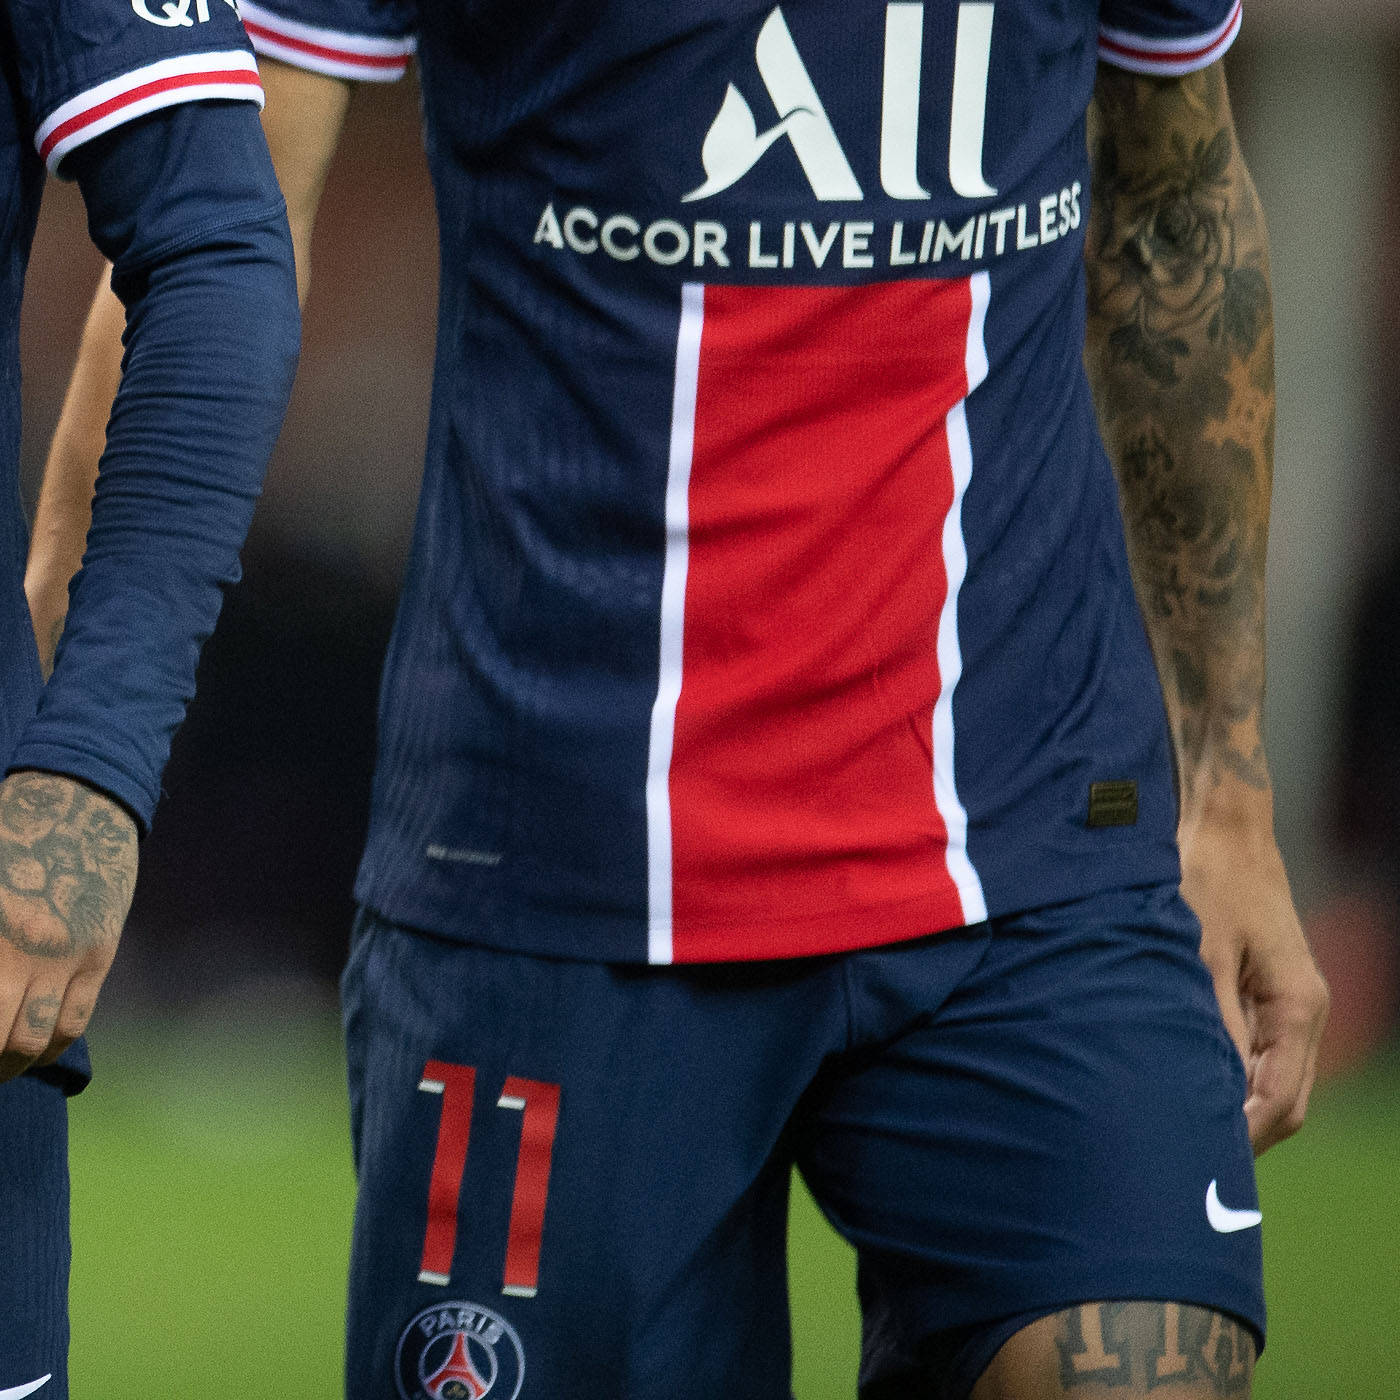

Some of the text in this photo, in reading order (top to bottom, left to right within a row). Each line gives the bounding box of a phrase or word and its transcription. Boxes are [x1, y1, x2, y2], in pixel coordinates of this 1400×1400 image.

[533, 180, 1082, 269] ACCOR LIVE LIMITLESS
[417, 1059, 562, 1299] 11
[420, 1308, 504, 1345] PARIS
